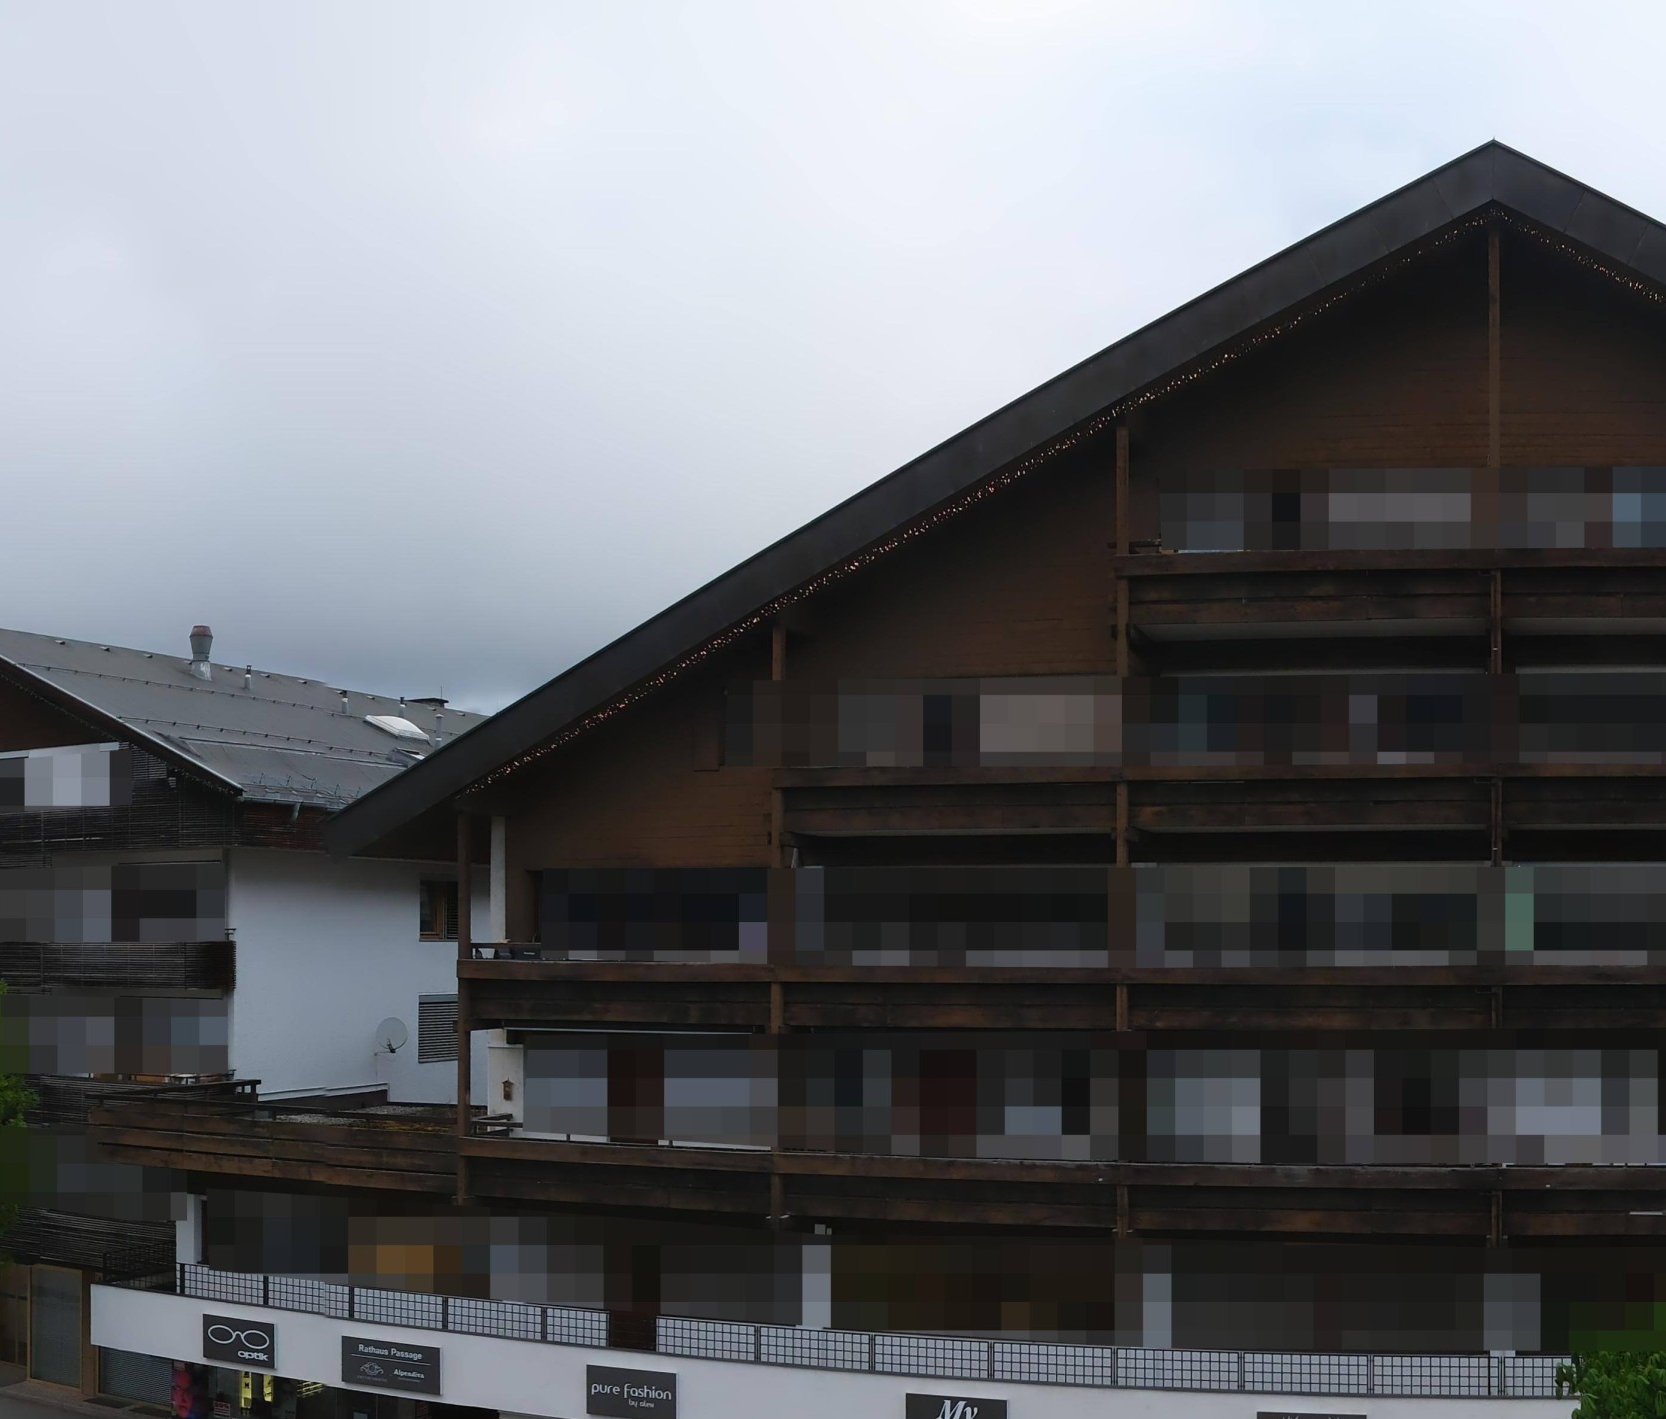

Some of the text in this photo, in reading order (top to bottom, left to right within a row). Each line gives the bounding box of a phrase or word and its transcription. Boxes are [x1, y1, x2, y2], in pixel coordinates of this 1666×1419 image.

[238, 1350, 269, 1362] optik
[358, 1344, 422, 1360] Rathaus Passage
[591, 1383, 672, 1400] pure fashion
[628, 1399, 638, 1408] by
